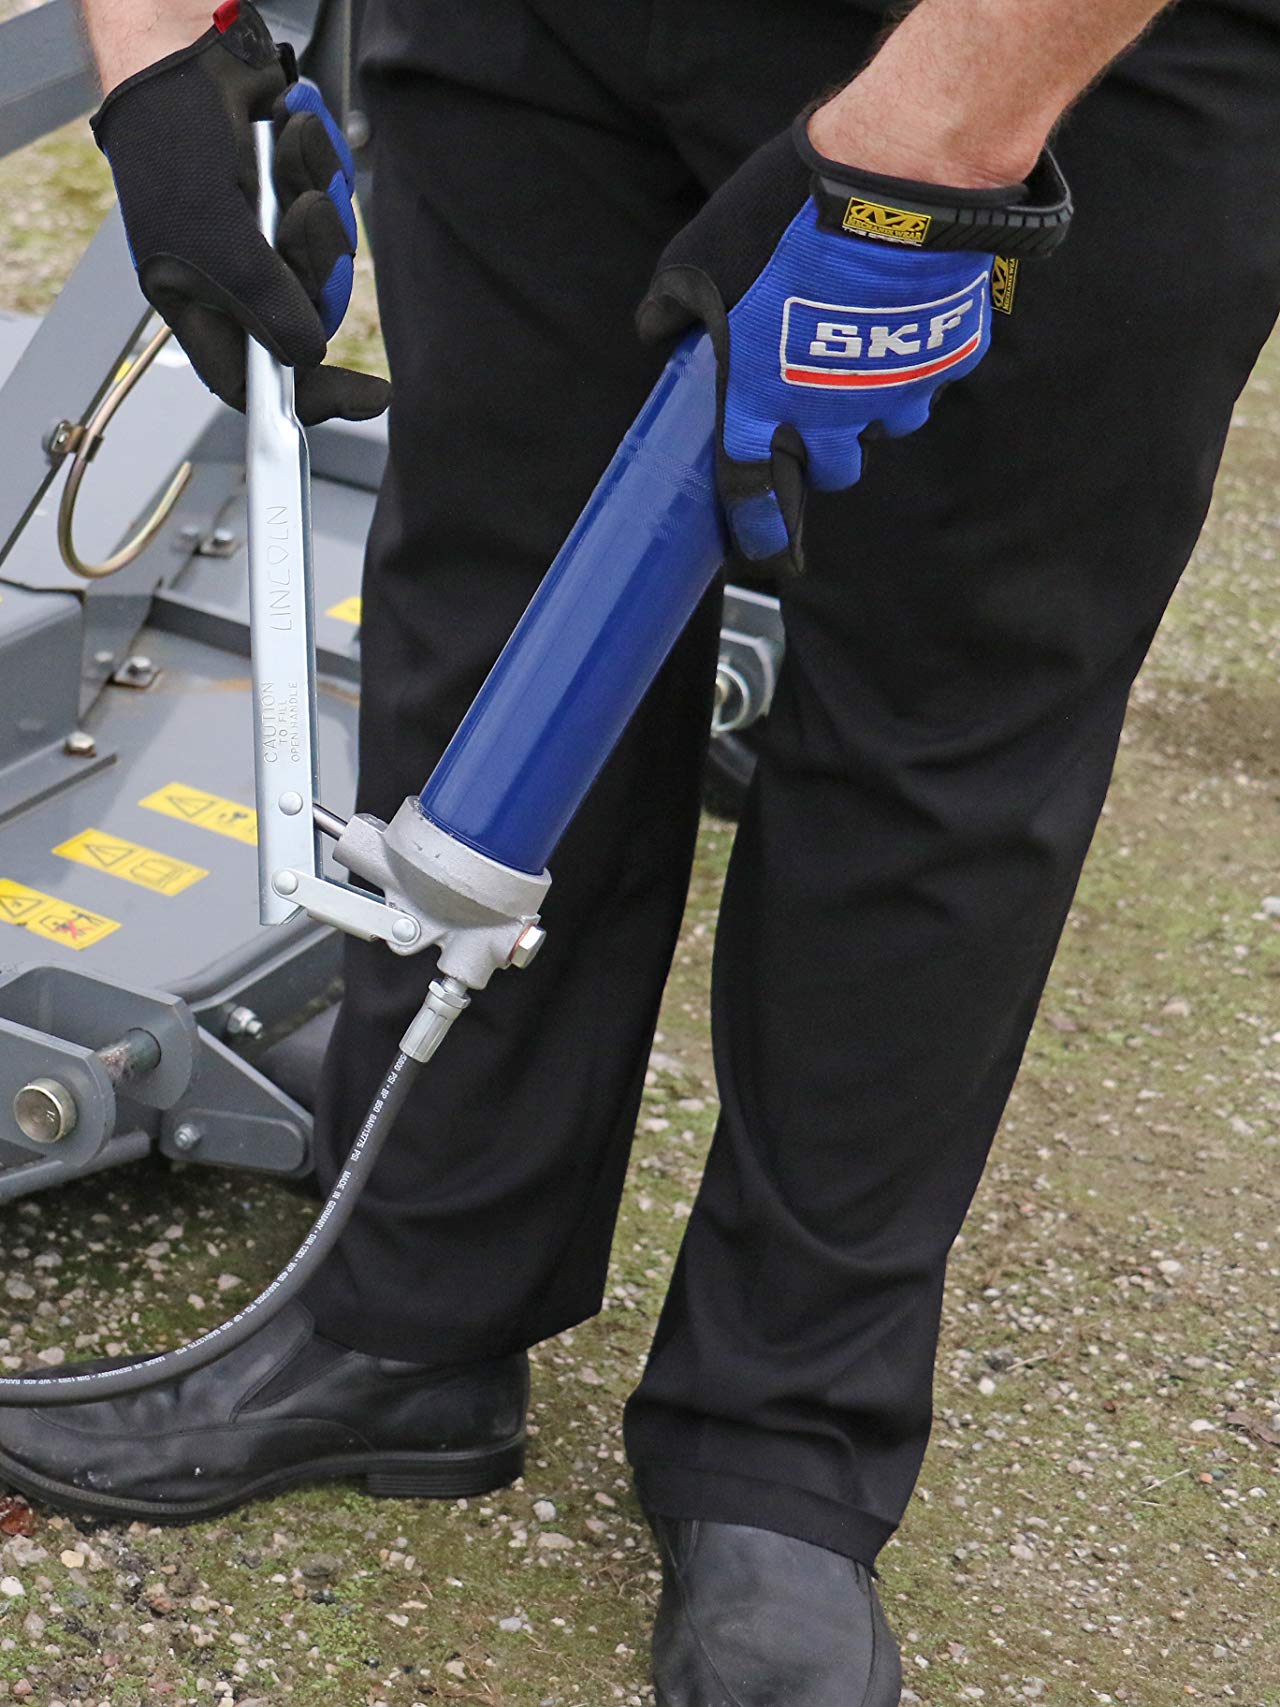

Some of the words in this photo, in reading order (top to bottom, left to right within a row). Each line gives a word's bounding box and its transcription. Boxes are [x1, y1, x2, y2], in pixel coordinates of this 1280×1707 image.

[894, 230, 922, 241] WEAR
[809, 299, 974, 358] SKF
[265, 505, 292, 631] LINCOLN
[278, 700, 288, 722] FILL
[289, 682, 298, 728] HANDLE
[261, 682, 278, 763] CAUTION
[279, 729, 288, 745] TO
[290, 732, 300, 762] OPEN
[386, 1071, 398, 1085] PSI
[379, 1087, 390, 1100] BP
[372, 1098, 384, 1114] 950
[349, 1149, 361, 1162] PSI
[336, 1169, 352, 1191] MADE
[331, 1190, 342, 1200] IN
[314, 1199, 337, 1231] GERMANY
